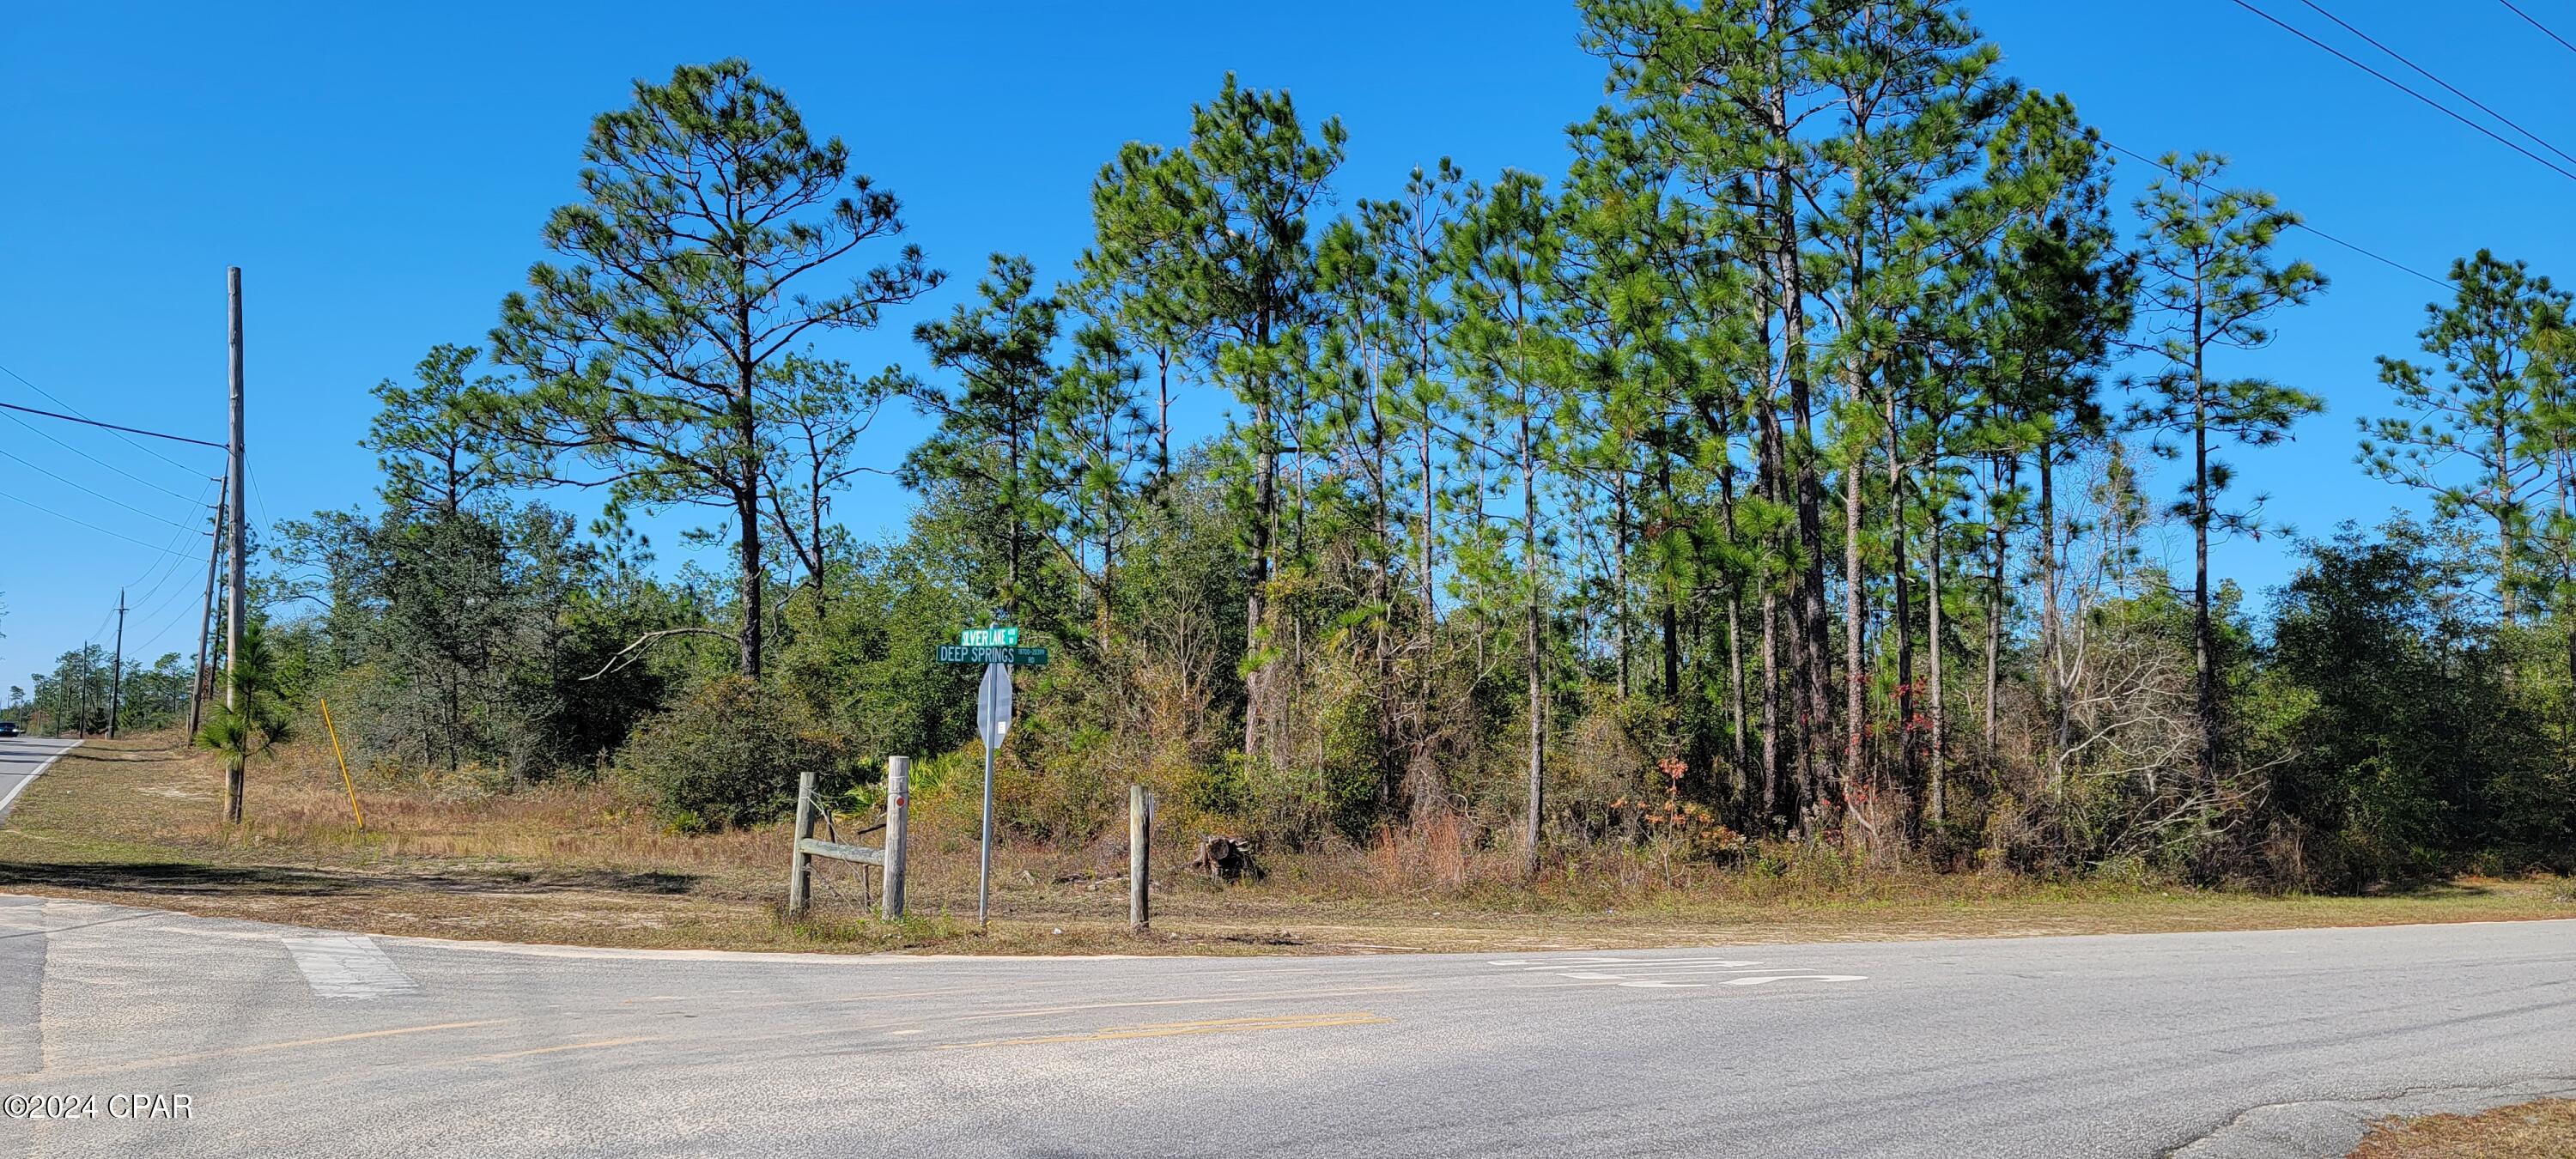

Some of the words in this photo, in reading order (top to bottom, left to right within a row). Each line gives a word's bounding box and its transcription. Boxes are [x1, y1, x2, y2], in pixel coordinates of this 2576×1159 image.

[962, 629, 988, 646] SILVER
[989, 629, 1006, 646] LAKE
[940, 646, 968, 661] DEEP
[971, 646, 1014, 663] SPRINGS
